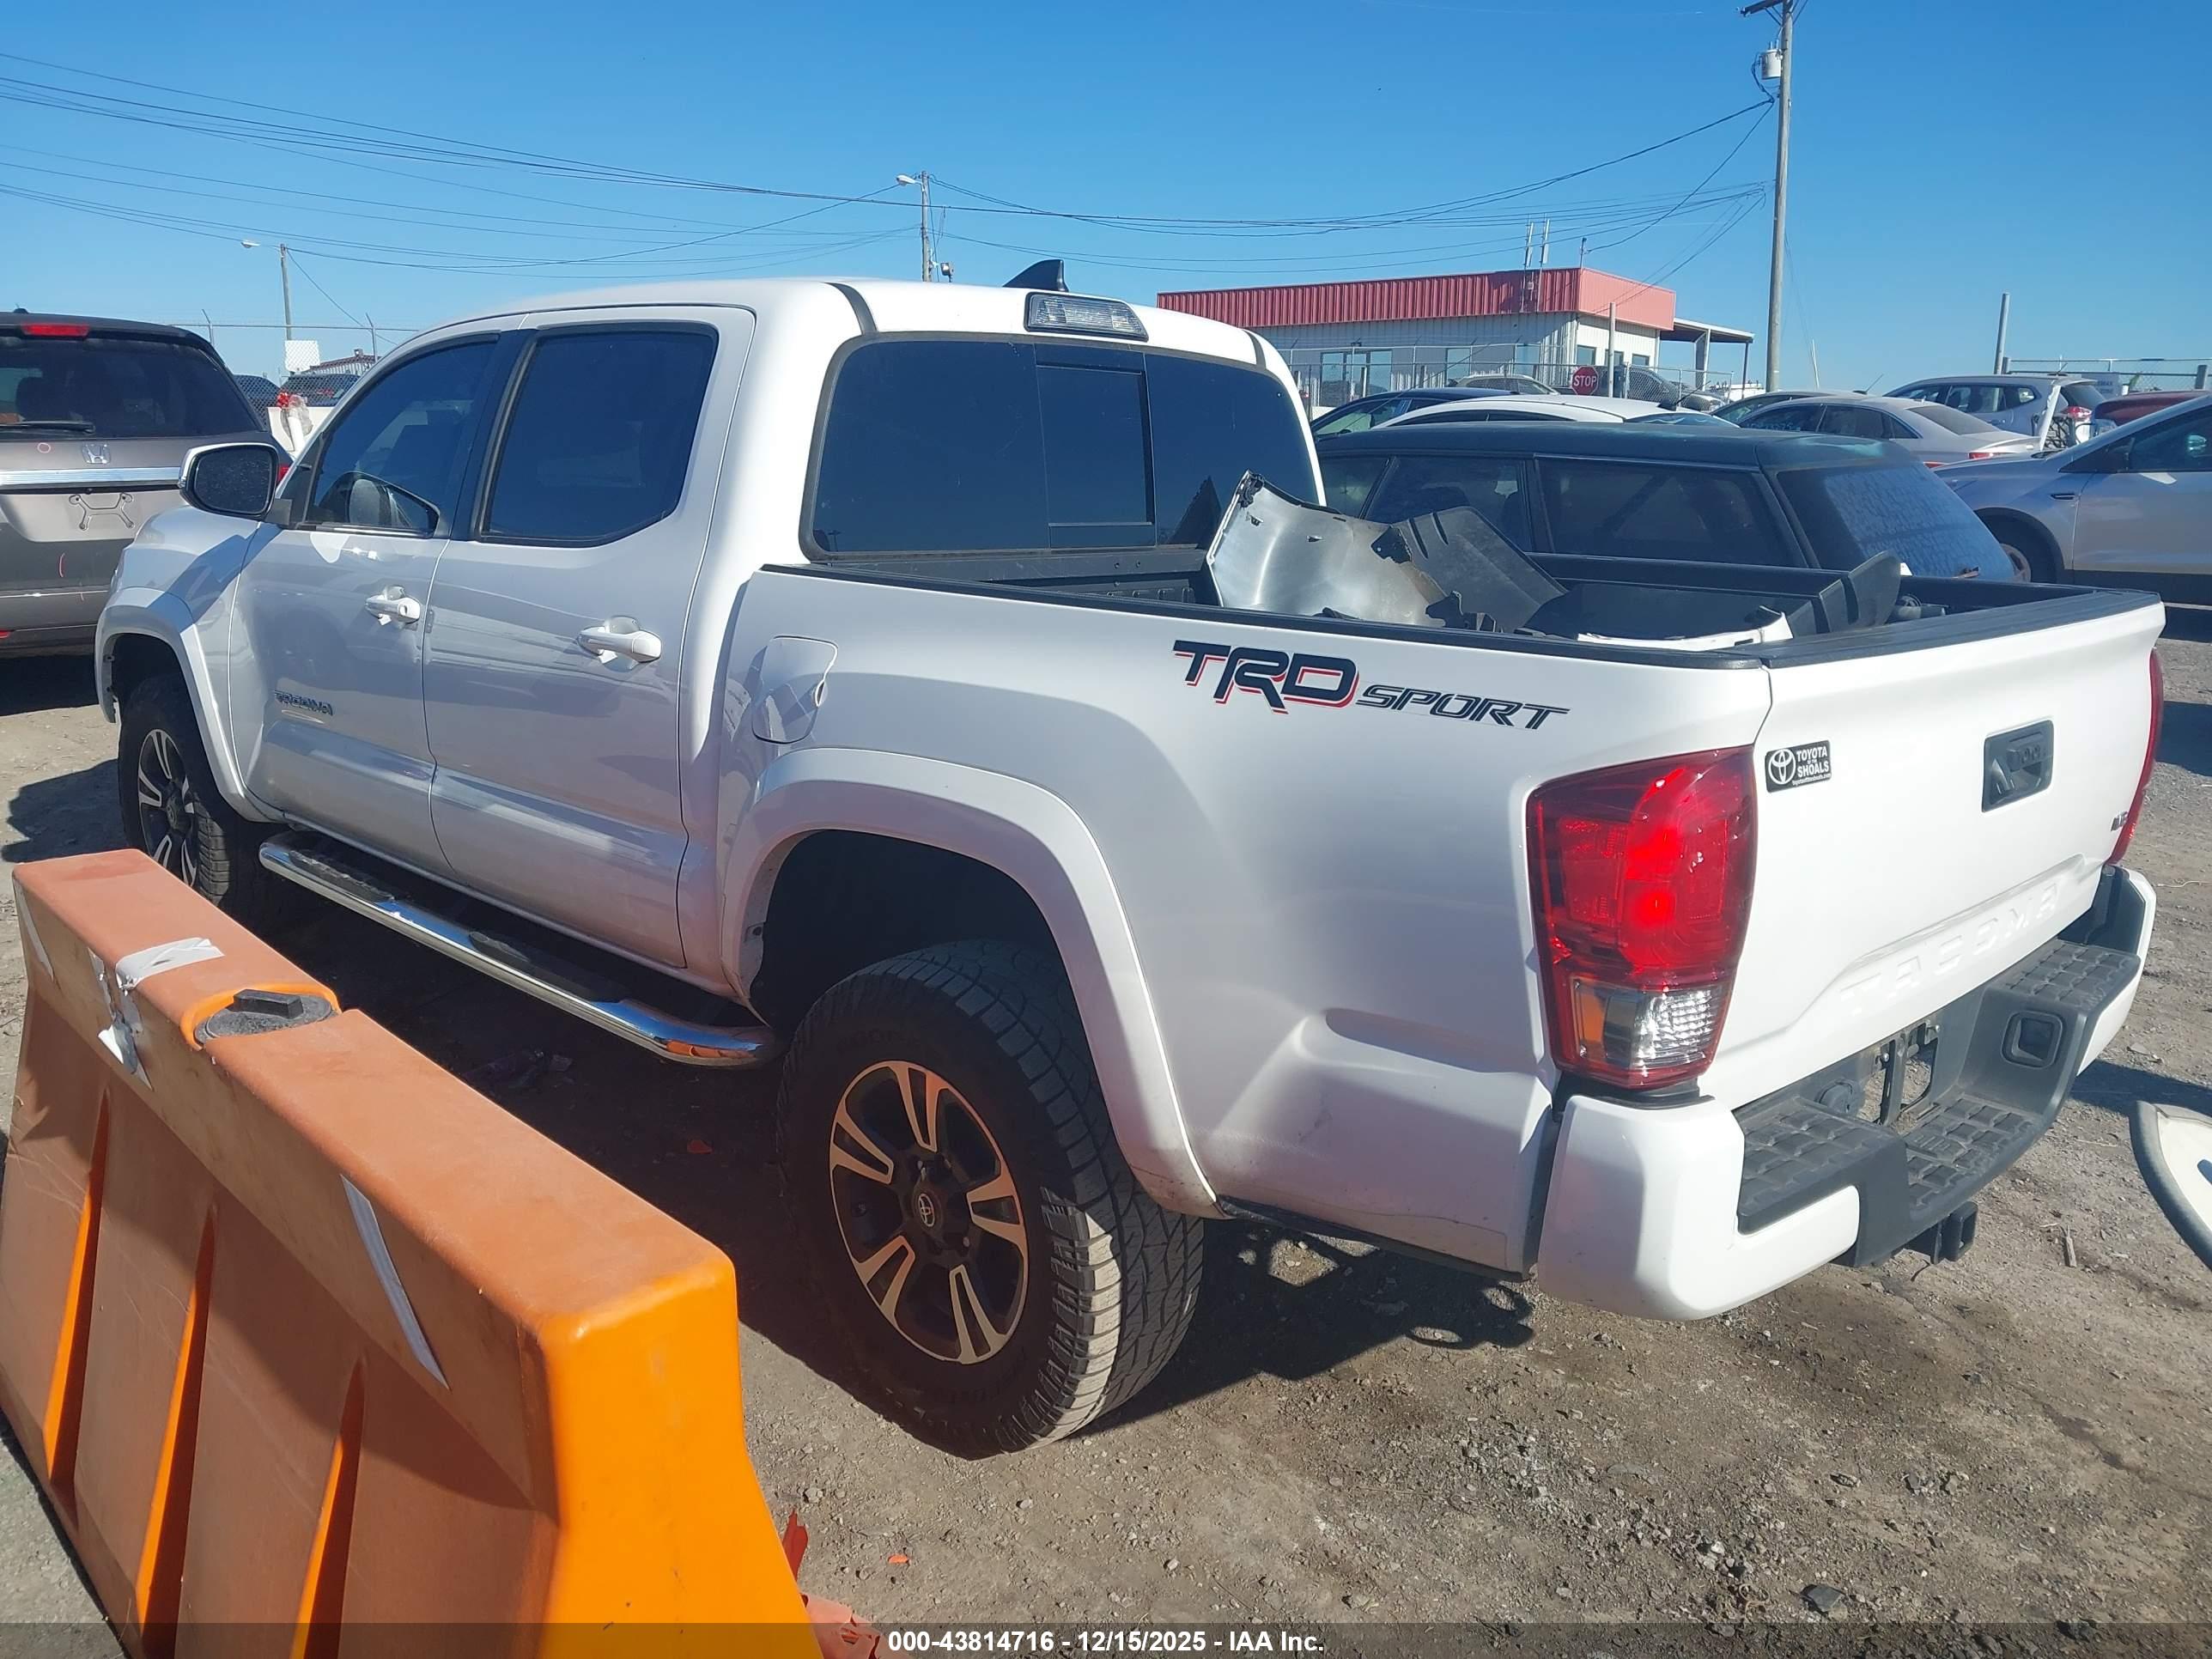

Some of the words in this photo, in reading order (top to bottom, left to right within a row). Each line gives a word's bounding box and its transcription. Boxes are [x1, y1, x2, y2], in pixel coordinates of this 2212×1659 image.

[1573, 375, 1597, 387] STOP
[1172, 640, 1360, 714] TRD
[1357, 684, 1571, 731] SPORT
[1796, 745, 1828, 763] TOYOTA
[1797, 761, 1829, 778] SHOALS
